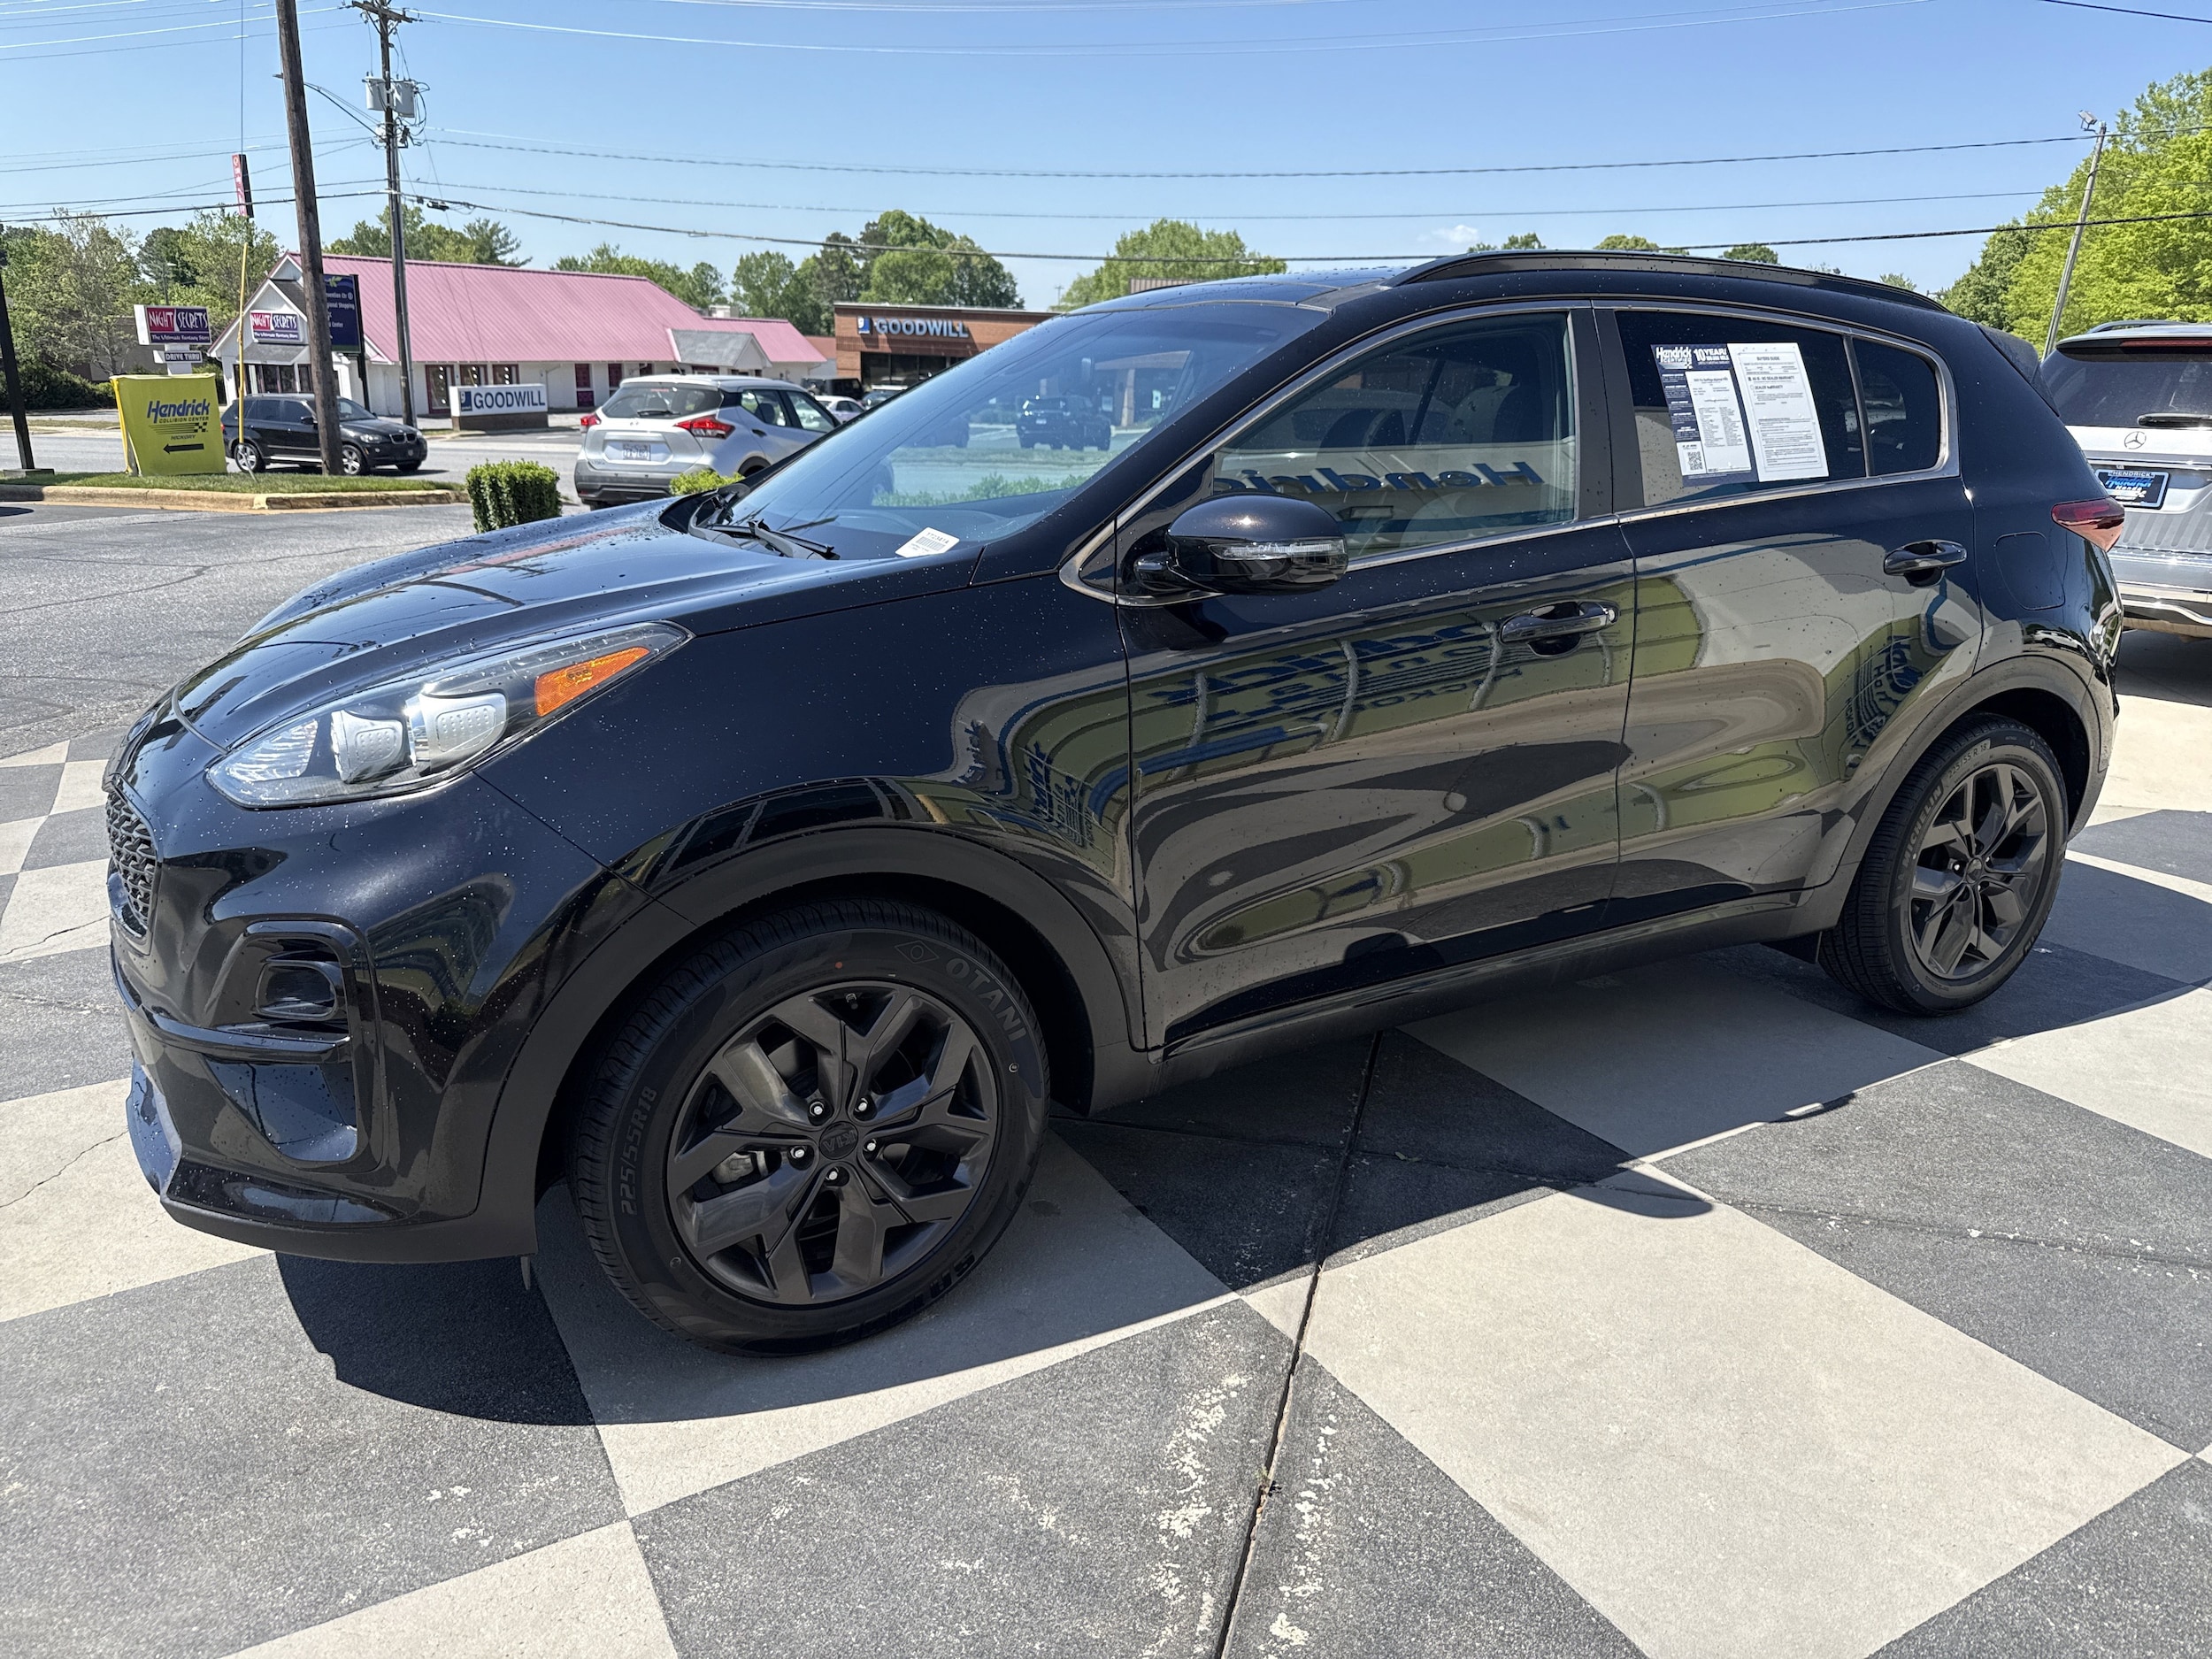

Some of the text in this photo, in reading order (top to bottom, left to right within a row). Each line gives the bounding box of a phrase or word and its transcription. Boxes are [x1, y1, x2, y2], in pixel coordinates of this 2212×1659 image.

[178, 311, 208, 329] SECRETS
[875, 318, 969, 338] GOODWILL
[1655, 346, 1692, 363] Hendrick
[147, 398, 211, 424] Hendrick
[473, 390, 546, 409] GOODWILL
[1901, 785, 1942, 868] MICHELIN
[945, 957, 1027, 1042] OTANI
[620, 1085, 657, 1216] 225/55R18
[822, 1129, 856, 1152] KIA
